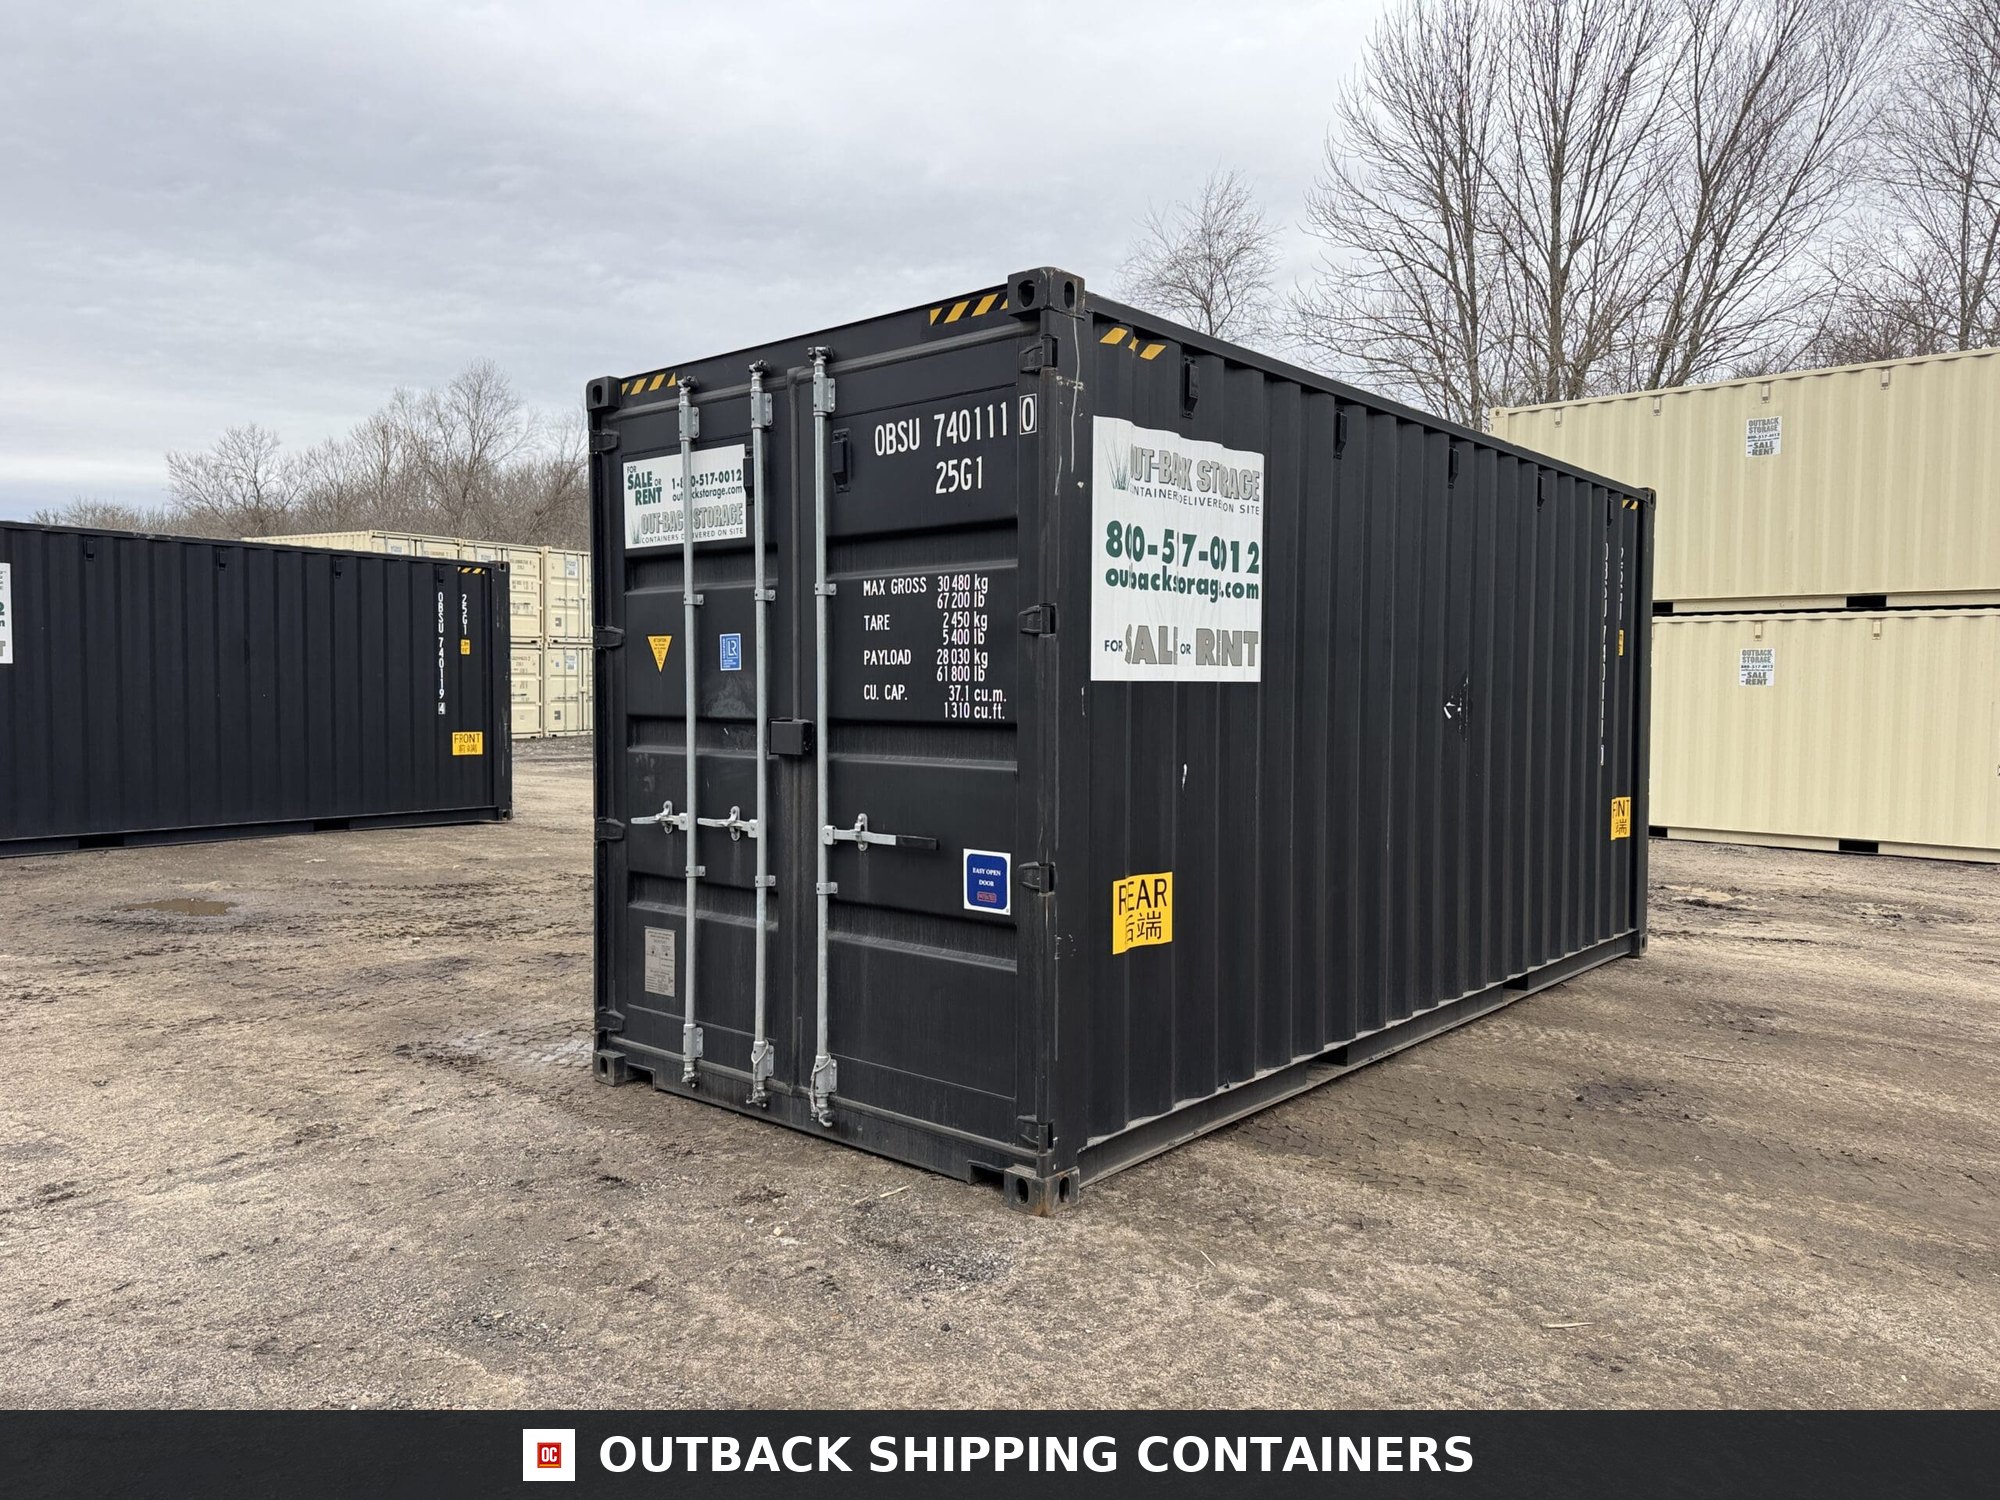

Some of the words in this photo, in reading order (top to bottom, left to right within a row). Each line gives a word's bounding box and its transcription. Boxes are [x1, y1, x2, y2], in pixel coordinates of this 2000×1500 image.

[874, 418, 920, 456] OBSU
[934, 401, 1007, 447] 740111
[1021, 396, 1036, 432] 0
[1752, 448, 1775, 456] RENT
[1753, 441, 1773, 449] SALE
[627, 466, 637, 474] FOR
[935, 456, 983, 494] 25G1
[1130, 443, 1193, 492] UT-BAK
[1196, 459, 1260, 502] STRAGE
[627, 471, 653, 490] SALE
[654, 478, 662, 486] OR
[671, 469, 742, 490] 1-0-517-0012
[635, 486, 662, 506] RENT
[672, 485, 743, 502] outckstorage.com
[1223, 502, 1234, 513] ON
[1240, 504, 1260, 515] SITE
[641, 510, 684, 535] OUT-BAC
[693, 503, 743, 529] STORAGE
[641, 534, 679, 544] CONTAINERS
[863, 579, 886, 596] MAX
[891, 577, 927, 594] GROSS
[974, 573, 989, 594] kg
[973, 591, 985, 608] lb
[864, 614, 890, 631] TARE
[973, 611, 988, 631] kg
[973, 629, 985, 645] lb
[1104, 640, 1123, 652] FOR
[1180, 643, 1191, 655] OR
[863, 649, 912, 665] PAYLOAD
[974, 648, 988, 669] kg
[974, 666, 985, 682] lb
[863, 685, 879, 700] CU.
[884, 684, 908, 700] CAP.
[948, 685, 969, 701] 37.1
[974, 688, 1007, 702] cu.m.
[974, 703, 1006, 719] cu.ft.
[454, 733, 481, 744] FRONT
[972, 867, 985, 875] EASY
[985, 869, 1001, 877] OPEN
[978, 879, 995, 887] DOOR
[1118, 878, 1168, 916] REAR
